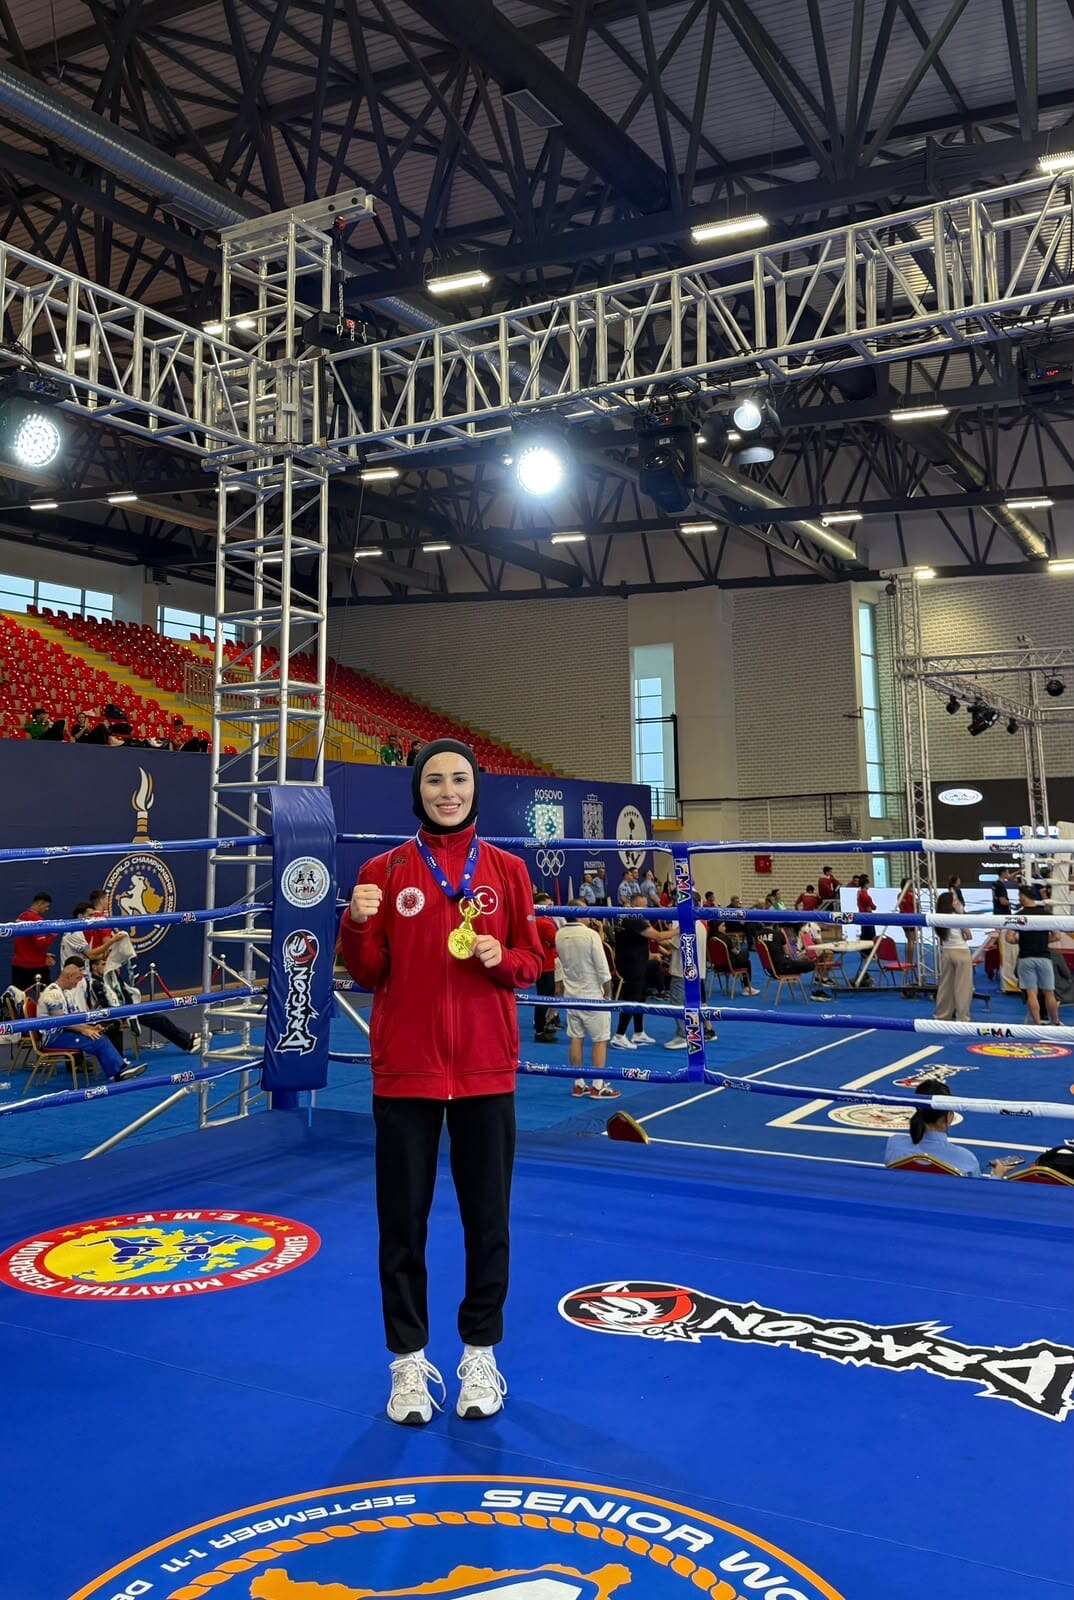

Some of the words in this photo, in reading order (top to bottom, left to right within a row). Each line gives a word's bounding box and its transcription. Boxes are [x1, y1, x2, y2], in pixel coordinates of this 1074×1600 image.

[535, 790, 562, 800] KOSOVO
[107, 860, 130, 887] WORLD
[280, 967, 312, 1048] DRAGON
[9, 1241, 65, 1291] FEDERATION
[231, 1235, 309, 1281] EUROPEAN
[62, 1274, 224, 1297] MUAYTHAI
[690, 1307, 1074, 1404] DRAGON
[208, 1494, 417, 1549] SEPTEMBER
[481, 1489, 714, 1553] SENIOR
[160, 1548, 208, 1573] 1-11
